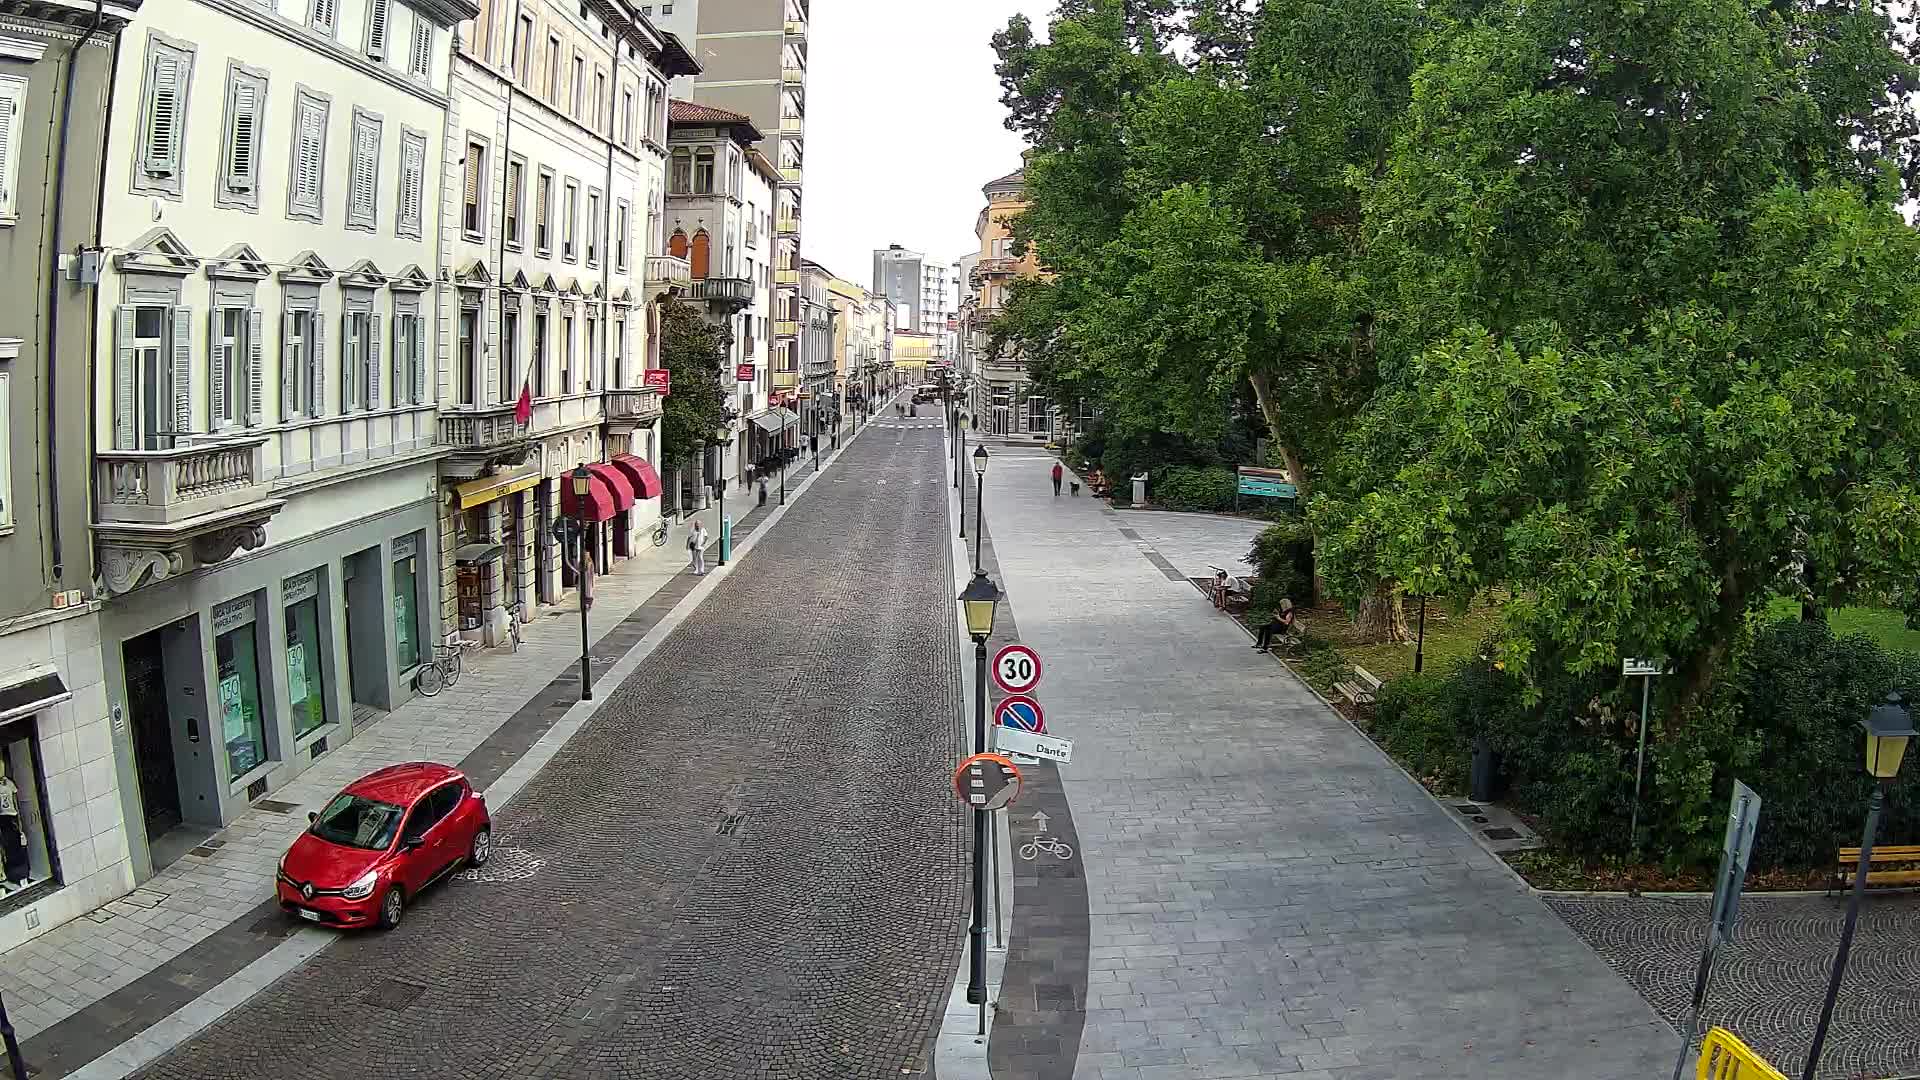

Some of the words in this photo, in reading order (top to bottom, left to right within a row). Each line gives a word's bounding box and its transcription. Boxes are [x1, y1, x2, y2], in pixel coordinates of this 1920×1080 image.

[1004, 658, 1031, 679] 30
[221, 678, 239, 700] 130
[1036, 743, 1066, 757] Dante
